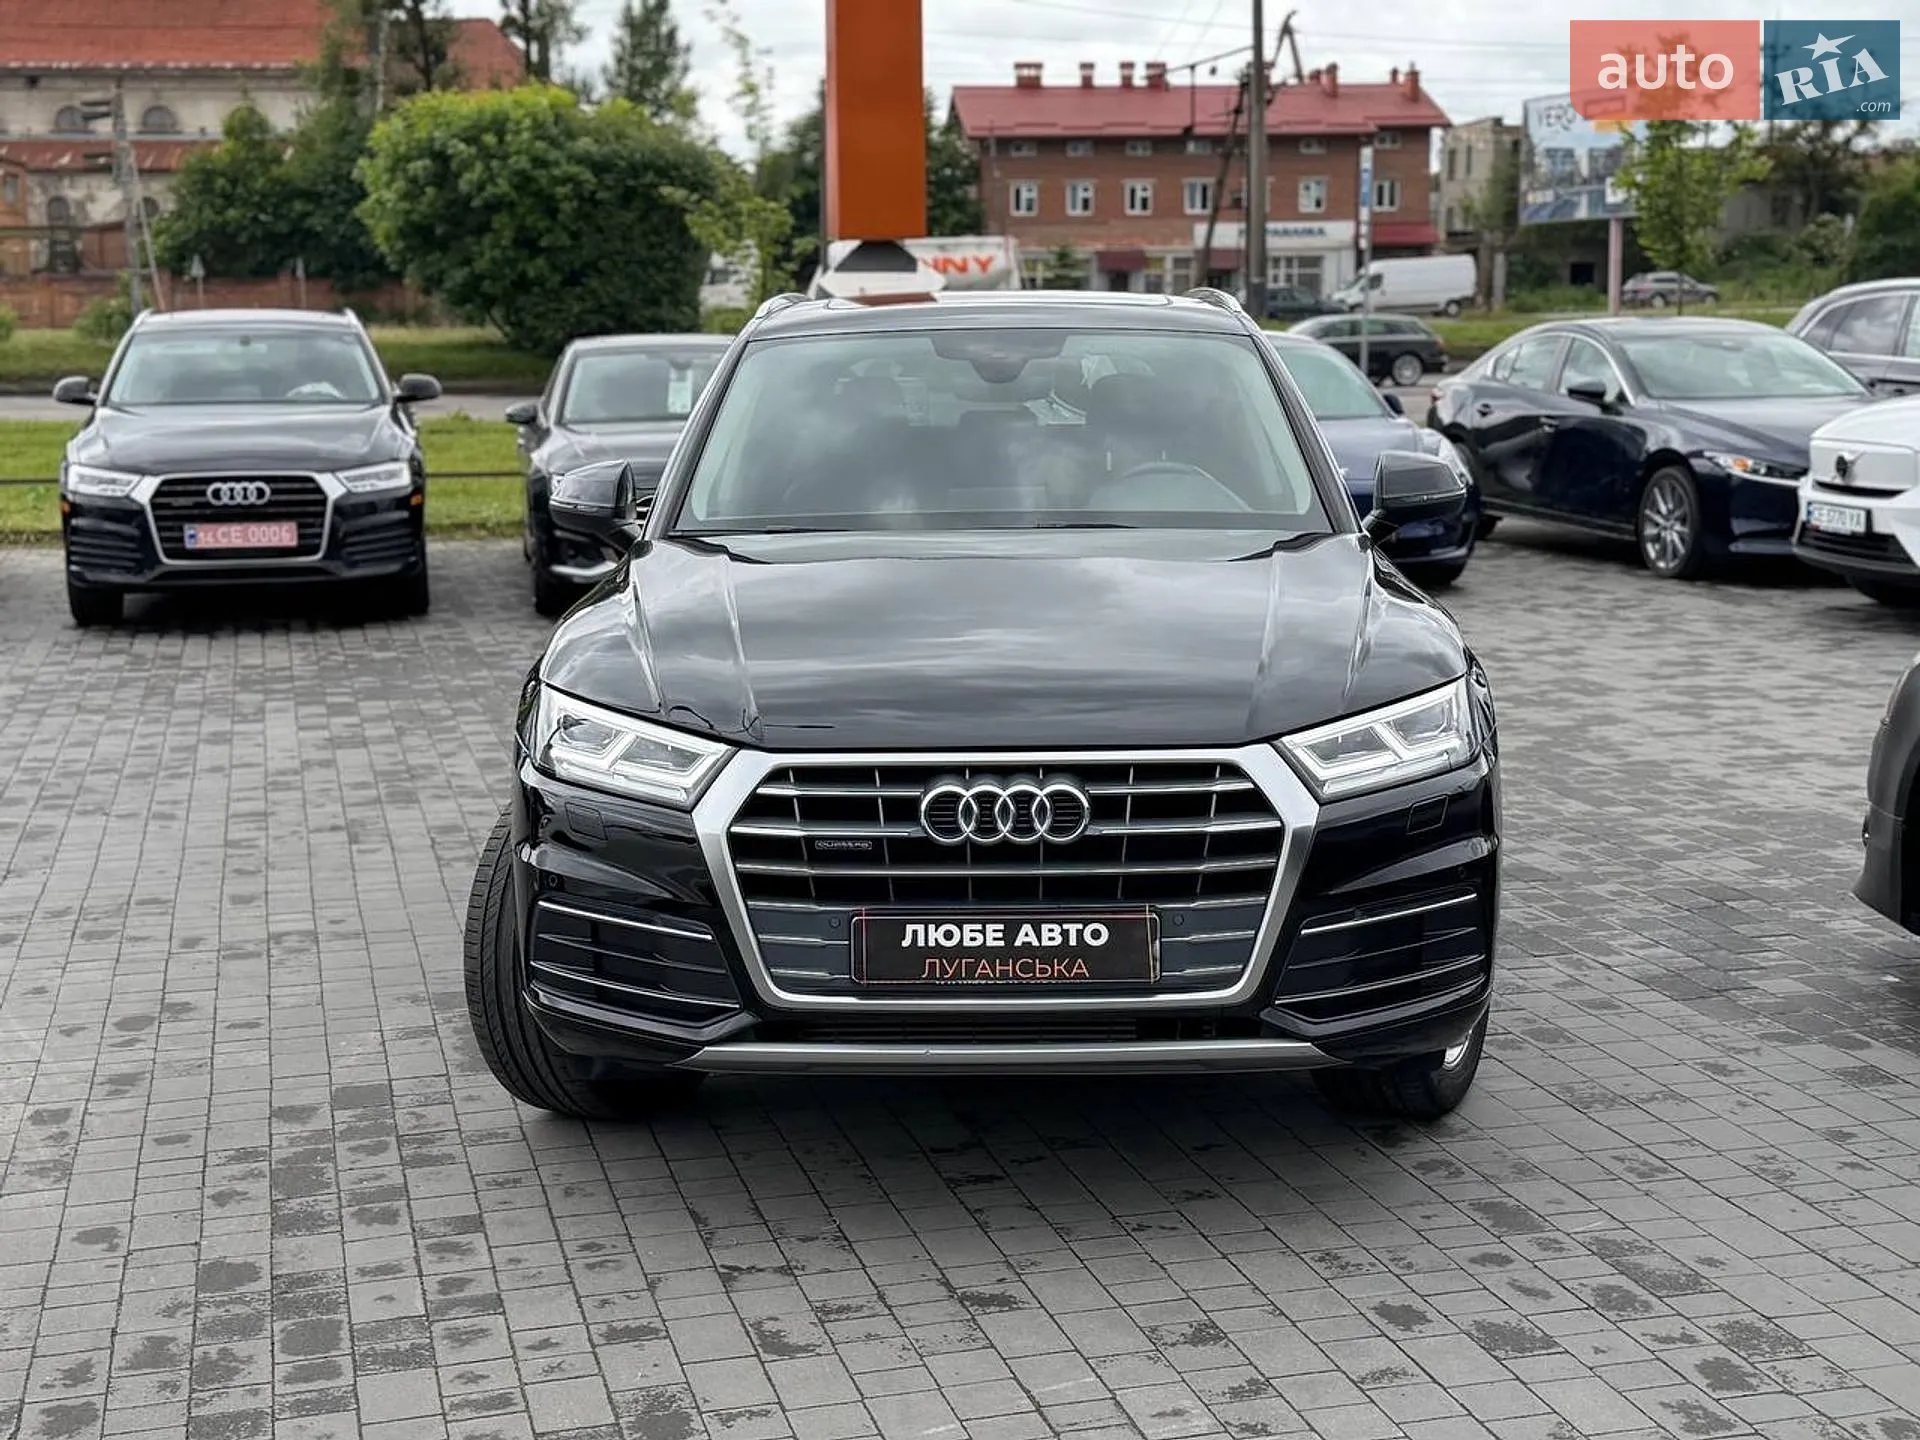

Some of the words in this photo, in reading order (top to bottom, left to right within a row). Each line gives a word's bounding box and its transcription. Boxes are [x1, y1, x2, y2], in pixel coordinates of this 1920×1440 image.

[901, 923, 1005, 948] ЛЮБЕ
[1014, 922, 1110, 947] АВТО
[921, 957, 1090, 979] ЛУГАНСЬКА
